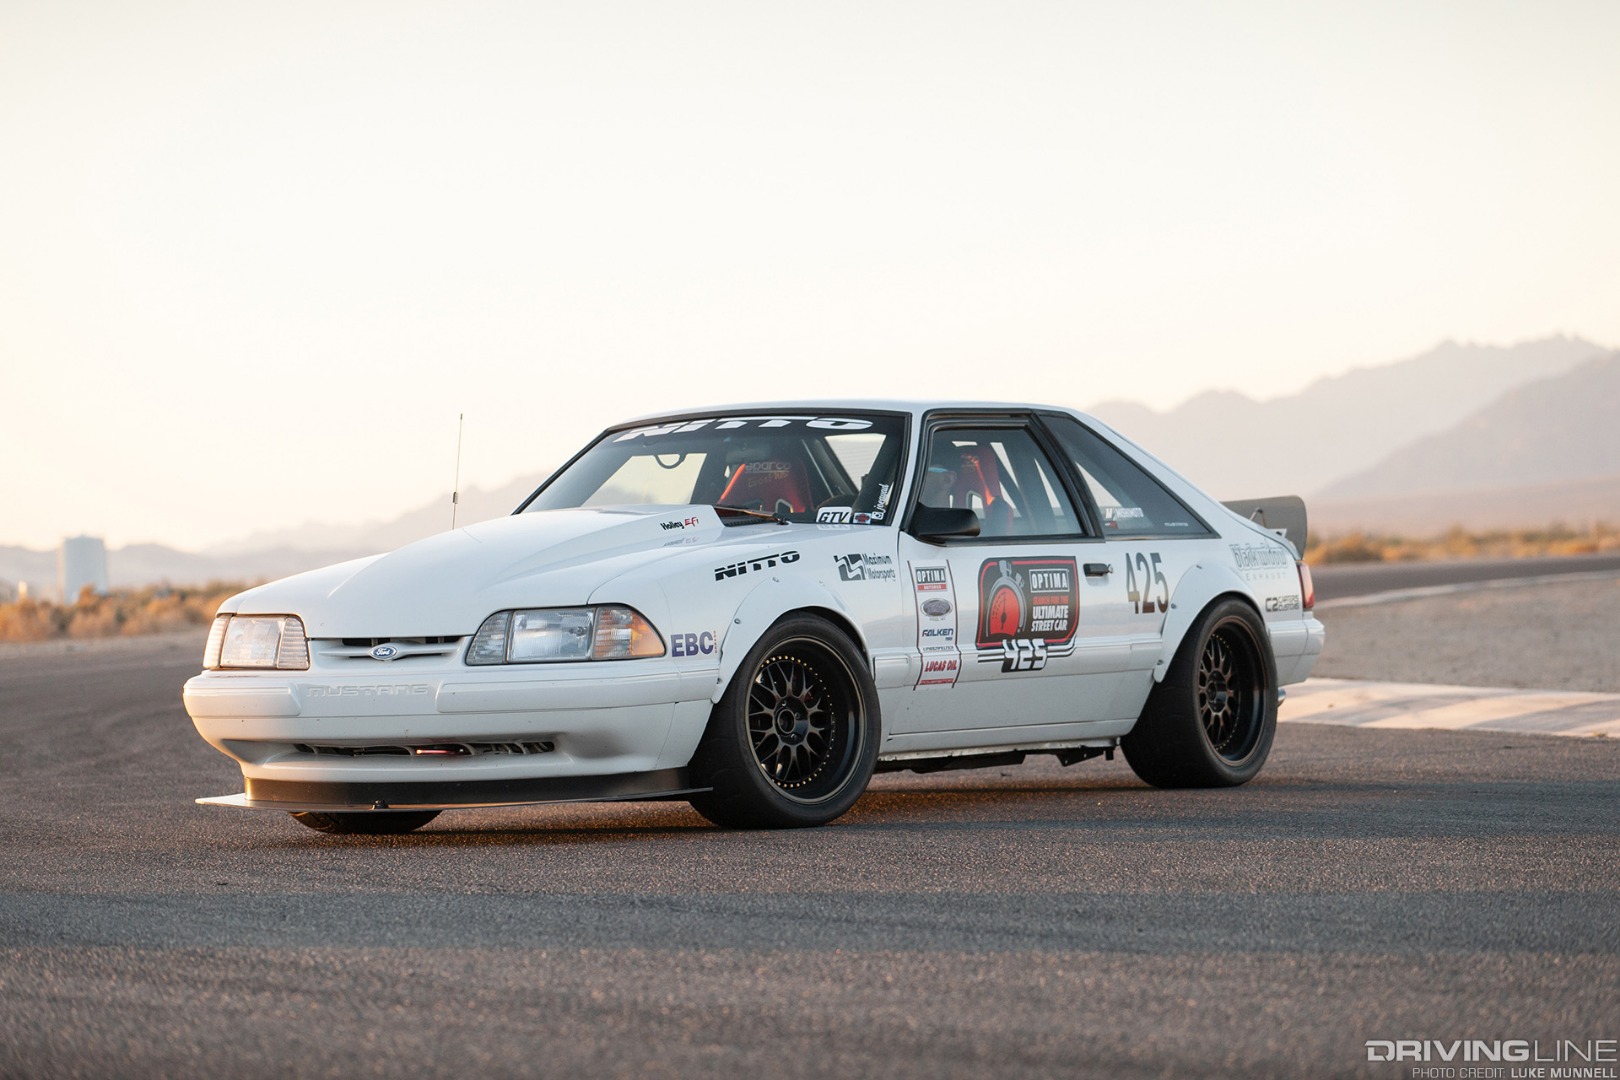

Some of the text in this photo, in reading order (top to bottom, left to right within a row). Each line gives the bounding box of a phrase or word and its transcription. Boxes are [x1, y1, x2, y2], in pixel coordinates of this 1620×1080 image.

[612, 416, 874, 443] NITTO
[820, 511, 850, 523] GTV
[660, 521, 685, 530] Holley
[714, 550, 800, 581] NITTO
[862, 553, 892, 565] Maximum
[917, 570, 945, 582] OPTIMA
[1031, 573, 1068, 589] OPTIMA
[1126, 552, 1169, 614] 425
[1265, 597, 1279, 612] C2
[1033, 605, 1069, 619] ULTIMATE
[922, 628, 954, 637] FALKEN
[1031, 620, 1068, 632] STREET CAR
[671, 631, 714, 657] EBC
[1002, 638, 1047, 670] 425
[924, 659, 958, 672] LUCAS OIL
[307, 684, 429, 697] MUSTANG
